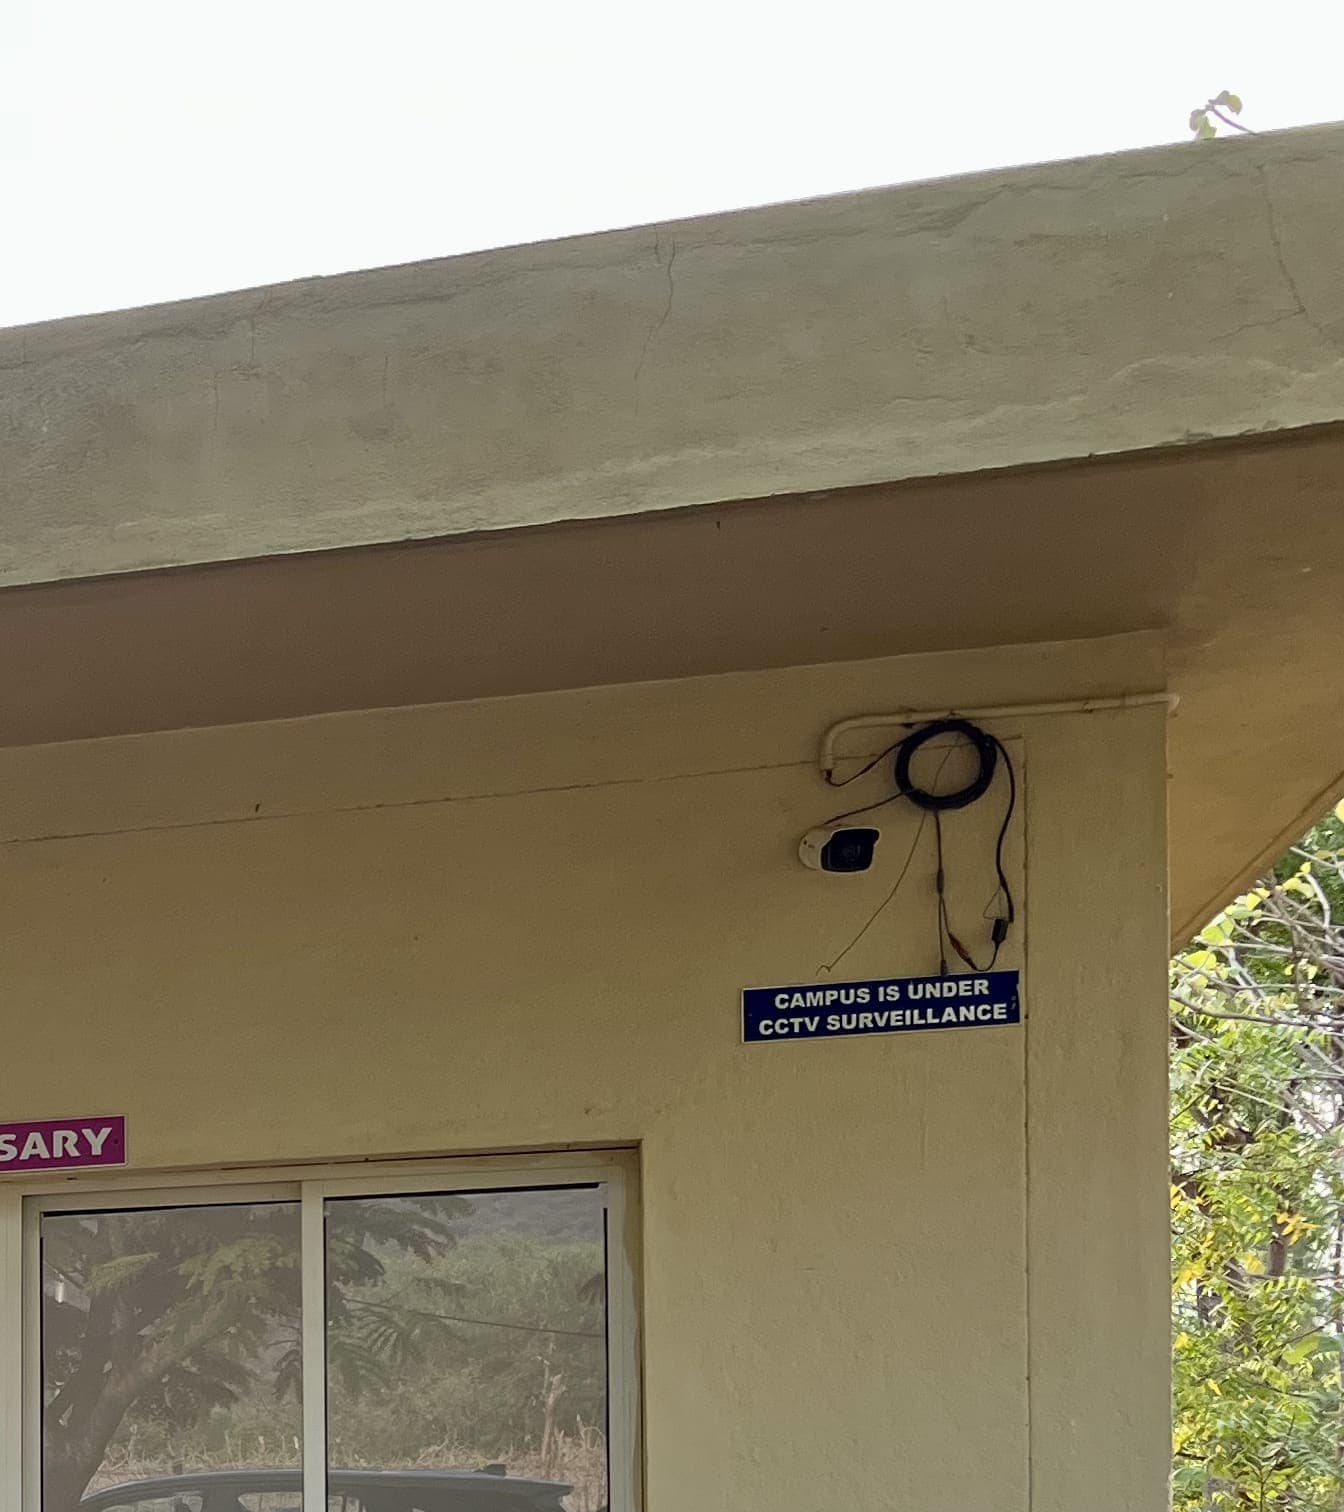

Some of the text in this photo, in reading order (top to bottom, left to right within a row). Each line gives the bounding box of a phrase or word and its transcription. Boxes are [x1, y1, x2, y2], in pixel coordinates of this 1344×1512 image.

[774, 979, 990, 1009] CAMPUS IS UNDER
[758, 1003, 1007, 1035] CCTV SURVEILLANCE
